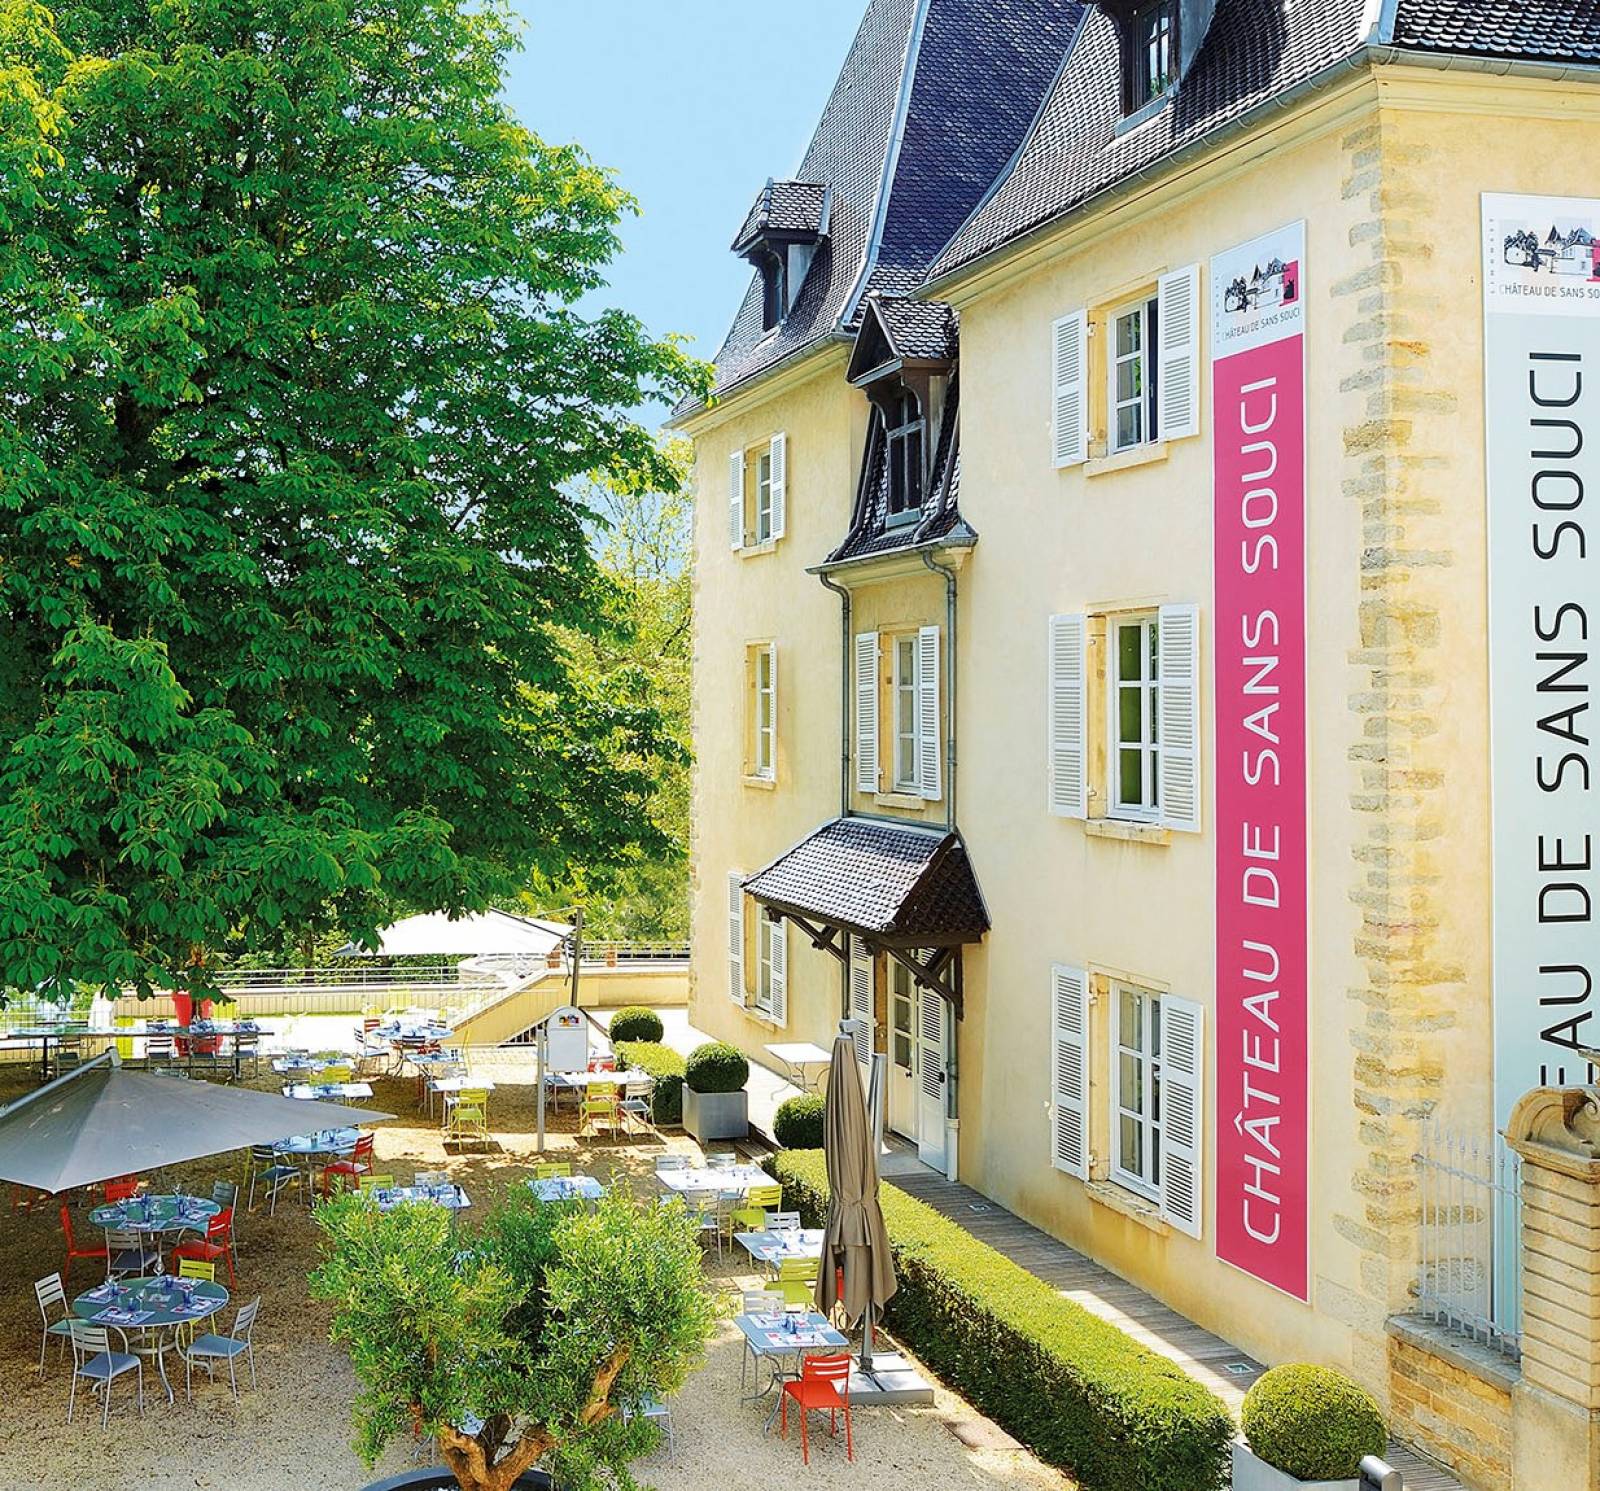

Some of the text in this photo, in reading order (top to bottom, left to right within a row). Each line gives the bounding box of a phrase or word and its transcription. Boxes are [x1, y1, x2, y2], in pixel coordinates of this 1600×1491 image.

[1250, 320, 1260, 332] DE
[1261, 314, 1279, 329] SANS
[1280, 307, 1300, 322] SOUCI
[1544, 286, 1557, 298] DE
[1560, 287, 1585, 299] SANS
[1529, 352, 1586, 560] SOUCI
[1534, 602, 1590, 793] SANS
[1233, 376, 1281, 1244] CHÂTEAU DE SANS SOUCI
[1538, 834, 1591, 924] DE
